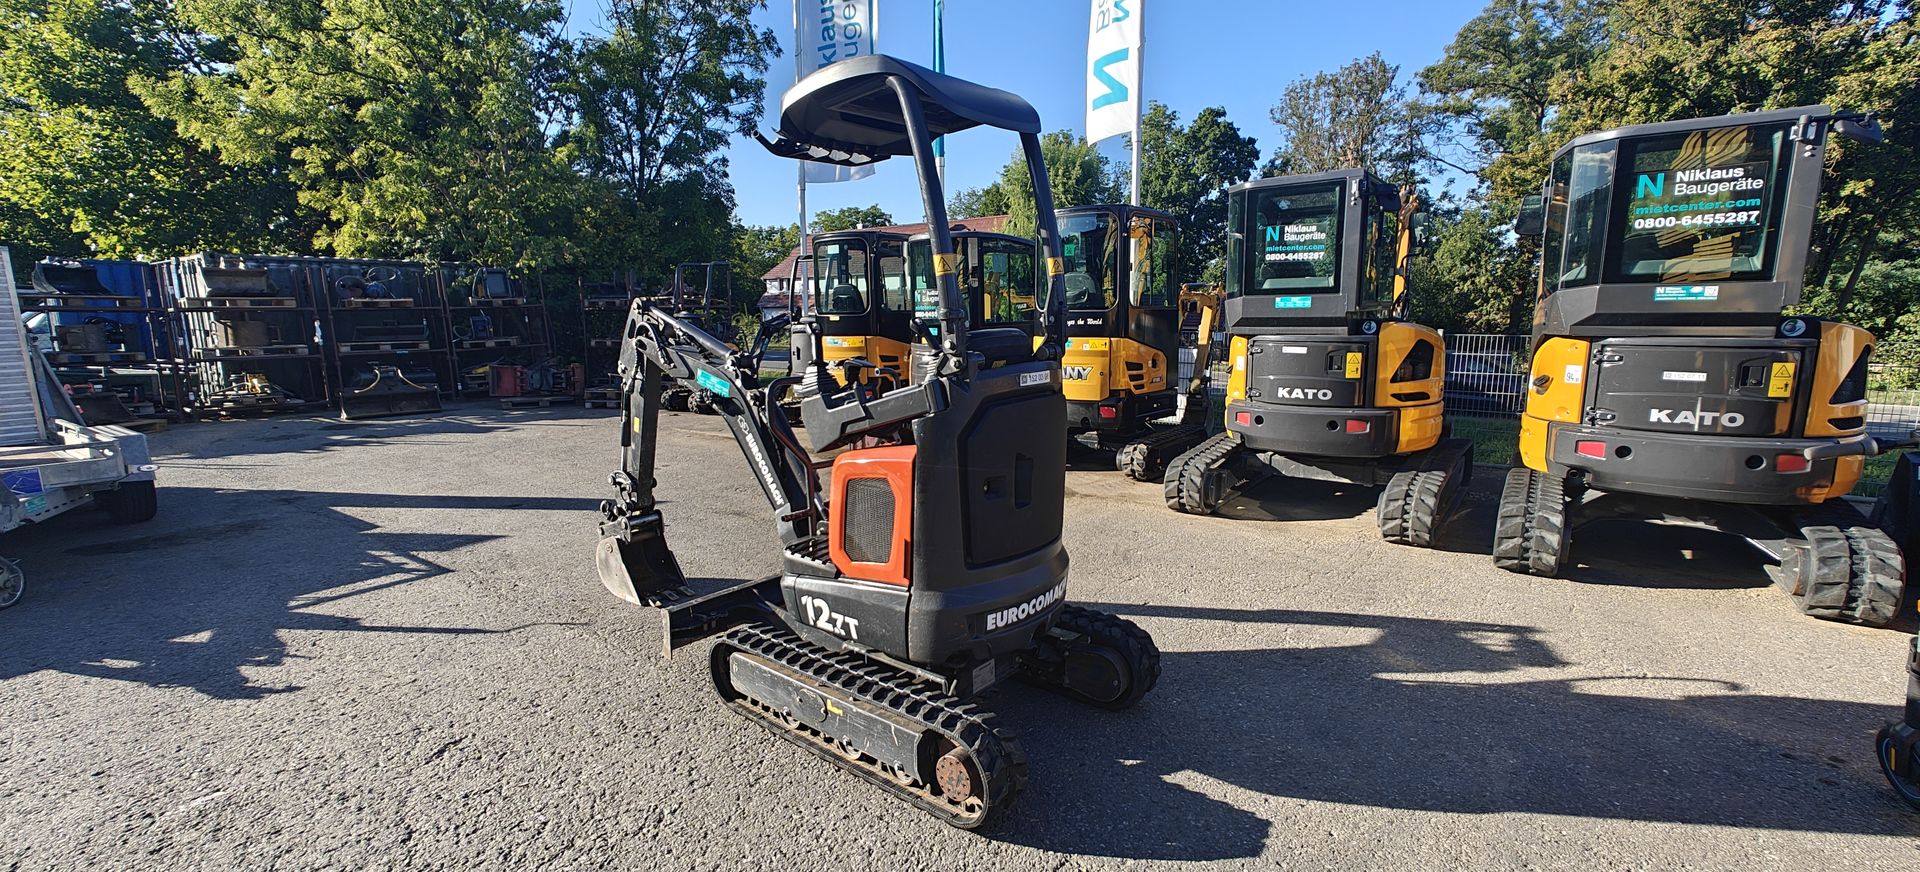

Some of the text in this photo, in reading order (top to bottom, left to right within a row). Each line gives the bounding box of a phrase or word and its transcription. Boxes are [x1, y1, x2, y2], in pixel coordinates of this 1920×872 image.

[1675, 167, 1744, 182] Niklaus
[1637, 173, 1664, 198] N
[1674, 178, 1764, 196] Baugeräte
[1635, 198, 1761, 215] mietcenter.com
[1634, 211, 1760, 228] 0800-6455287
[1265, 226, 1280, 242] N
[1284, 225, 1317, 233] Niklaus
[1284, 232, 1326, 242] Baugeräte
[1265, 244, 1325, 252] mietcenter.com
[1265, 251, 1325, 261] 0800-6455287
[1277, 387, 1333, 401] KATO
[1650, 408, 1744, 427] KATO
[745, 432, 786, 506] EUROCOMACH
